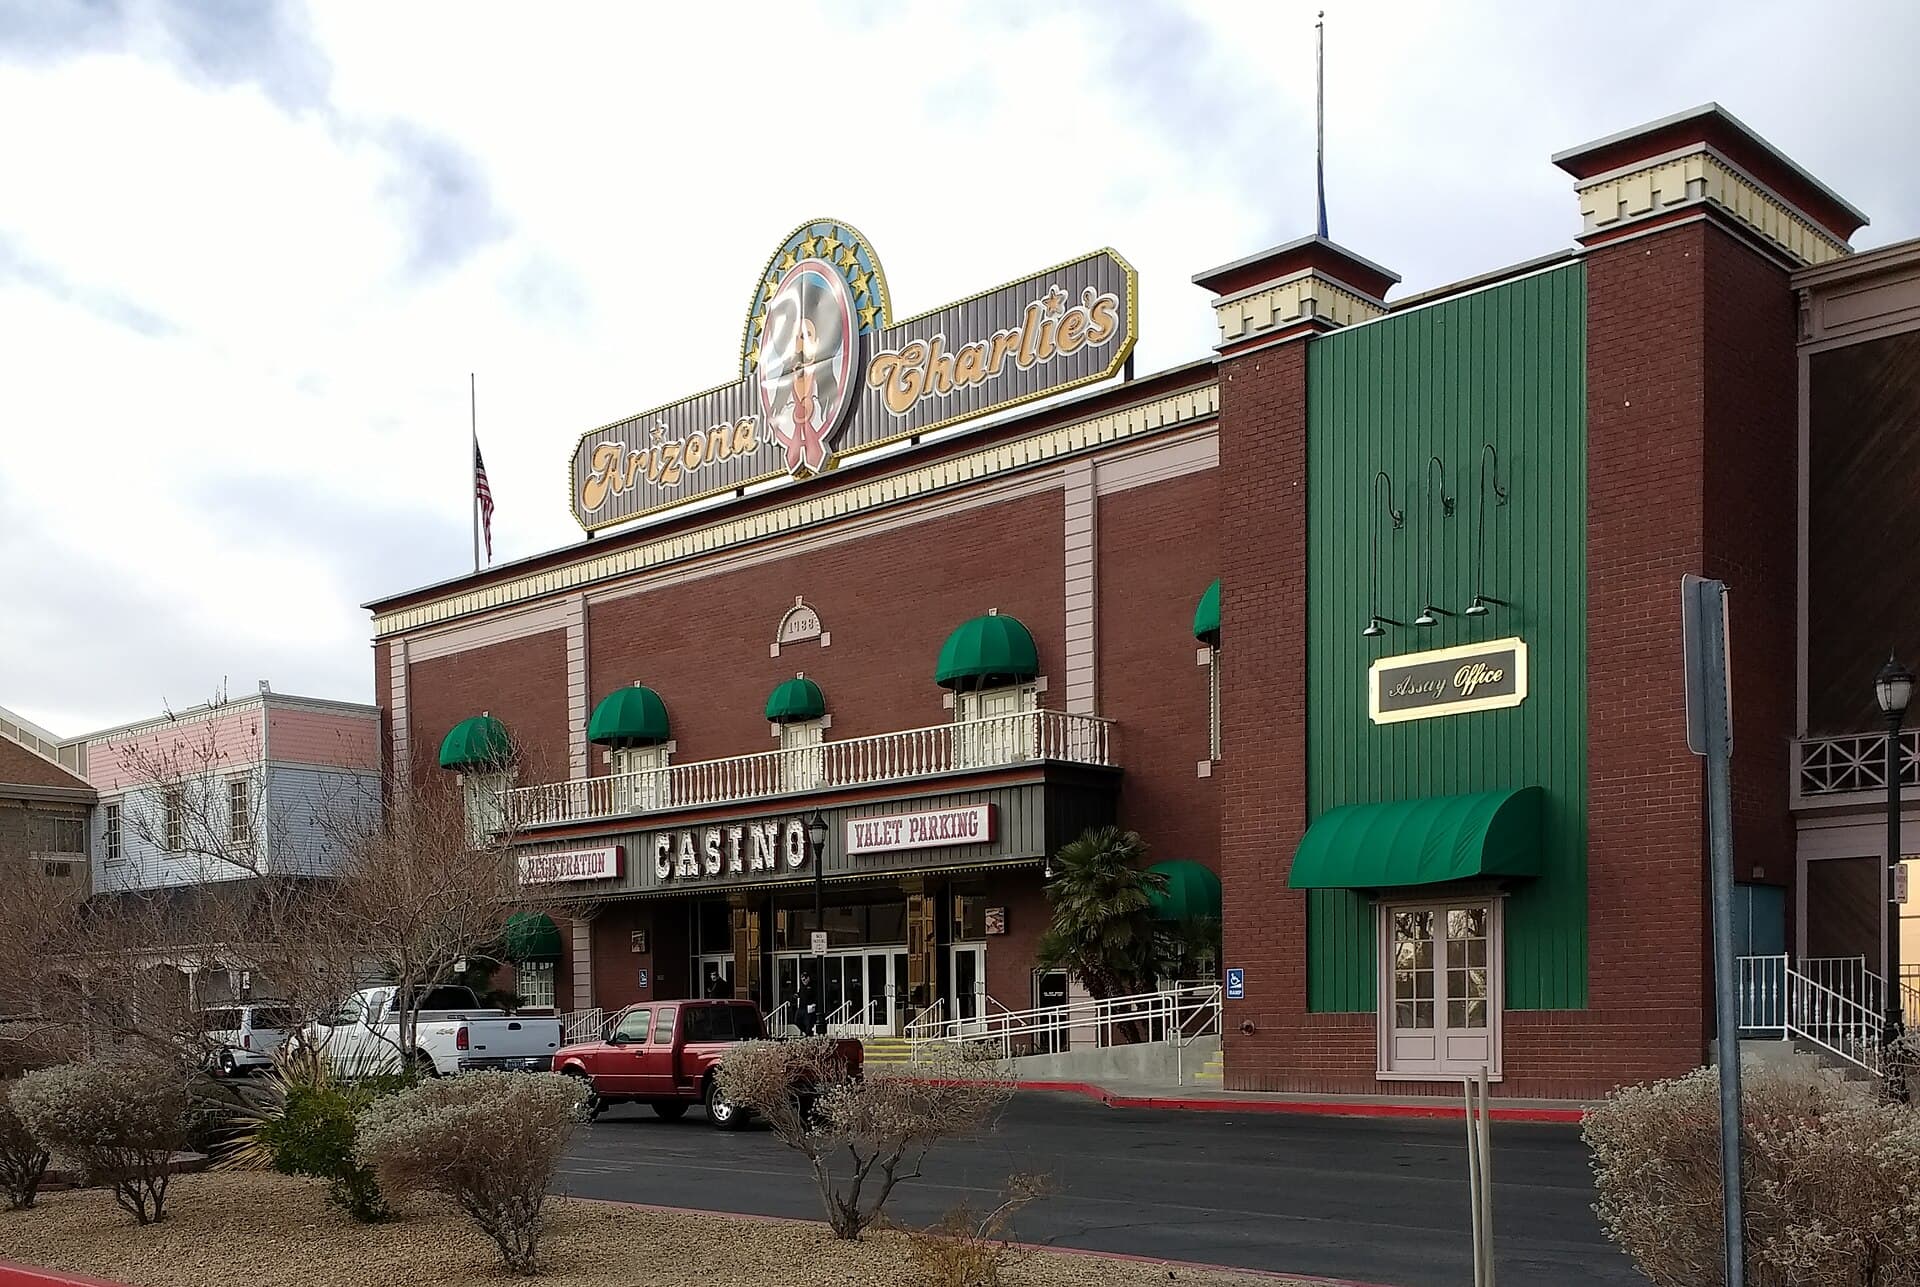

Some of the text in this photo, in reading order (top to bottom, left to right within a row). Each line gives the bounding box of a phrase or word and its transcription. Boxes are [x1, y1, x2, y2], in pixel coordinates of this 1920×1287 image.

[581, 285, 1119, 513] Arizona Charlie's
[1388, 662, 1504, 699] Assay Office
[854, 810, 979, 848] VALET PARKING
[527, 852, 606, 879] REGISTRATION
[655, 817, 806, 880] CASINO
